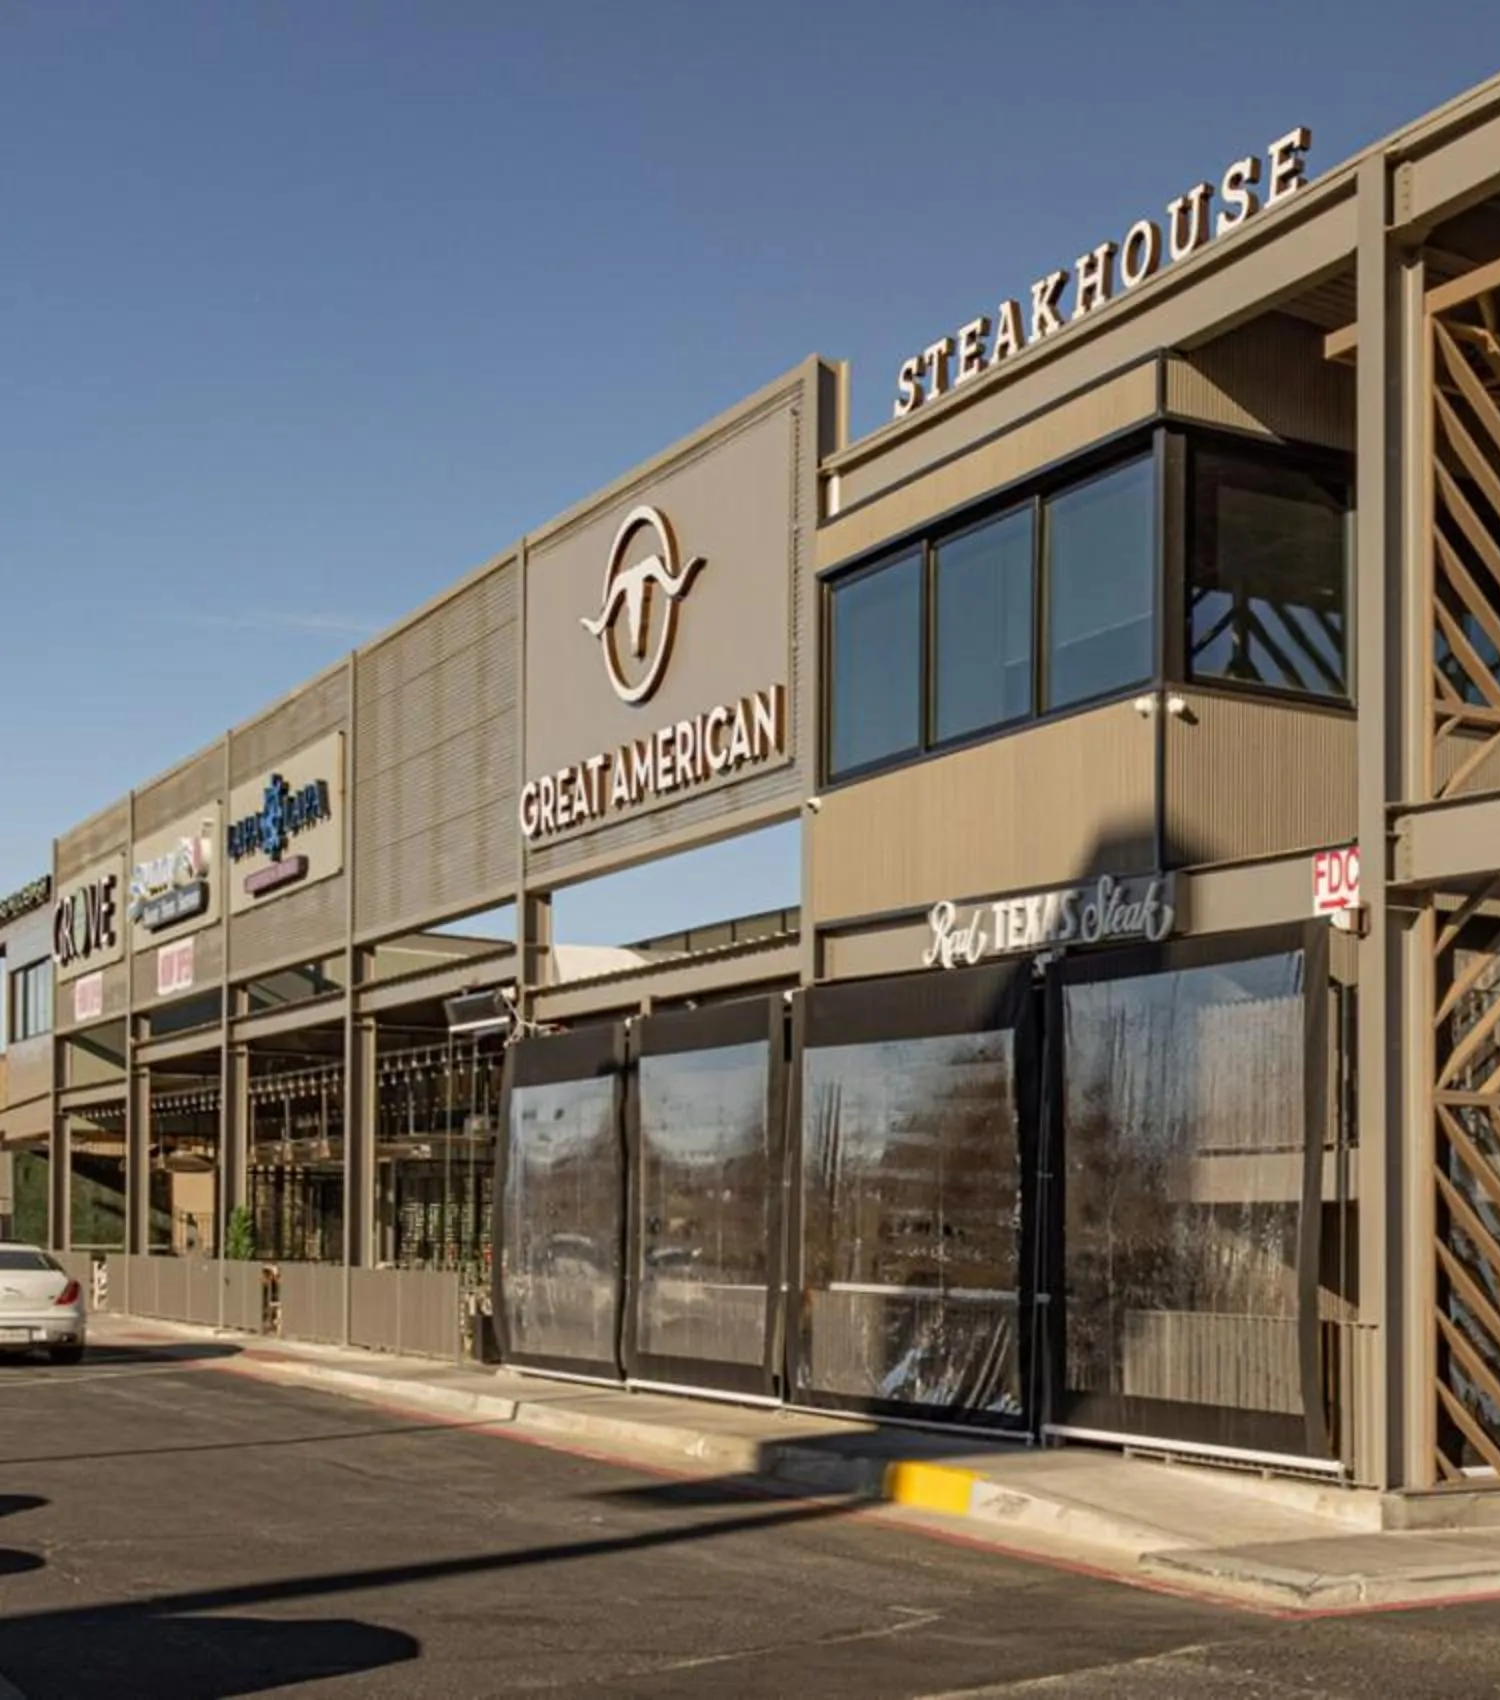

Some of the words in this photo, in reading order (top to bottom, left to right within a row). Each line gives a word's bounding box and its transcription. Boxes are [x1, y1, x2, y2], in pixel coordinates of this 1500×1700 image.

[893, 126, 1311, 419] STEAKHOUSE
[519, 753, 610, 838] GREAT
[611, 684, 783, 808] AMERICAN
[992, 889, 1078, 949] TEXAS
[1081, 875, 1175, 942] Steak
[1314, 845, 1360, 896] FDC
